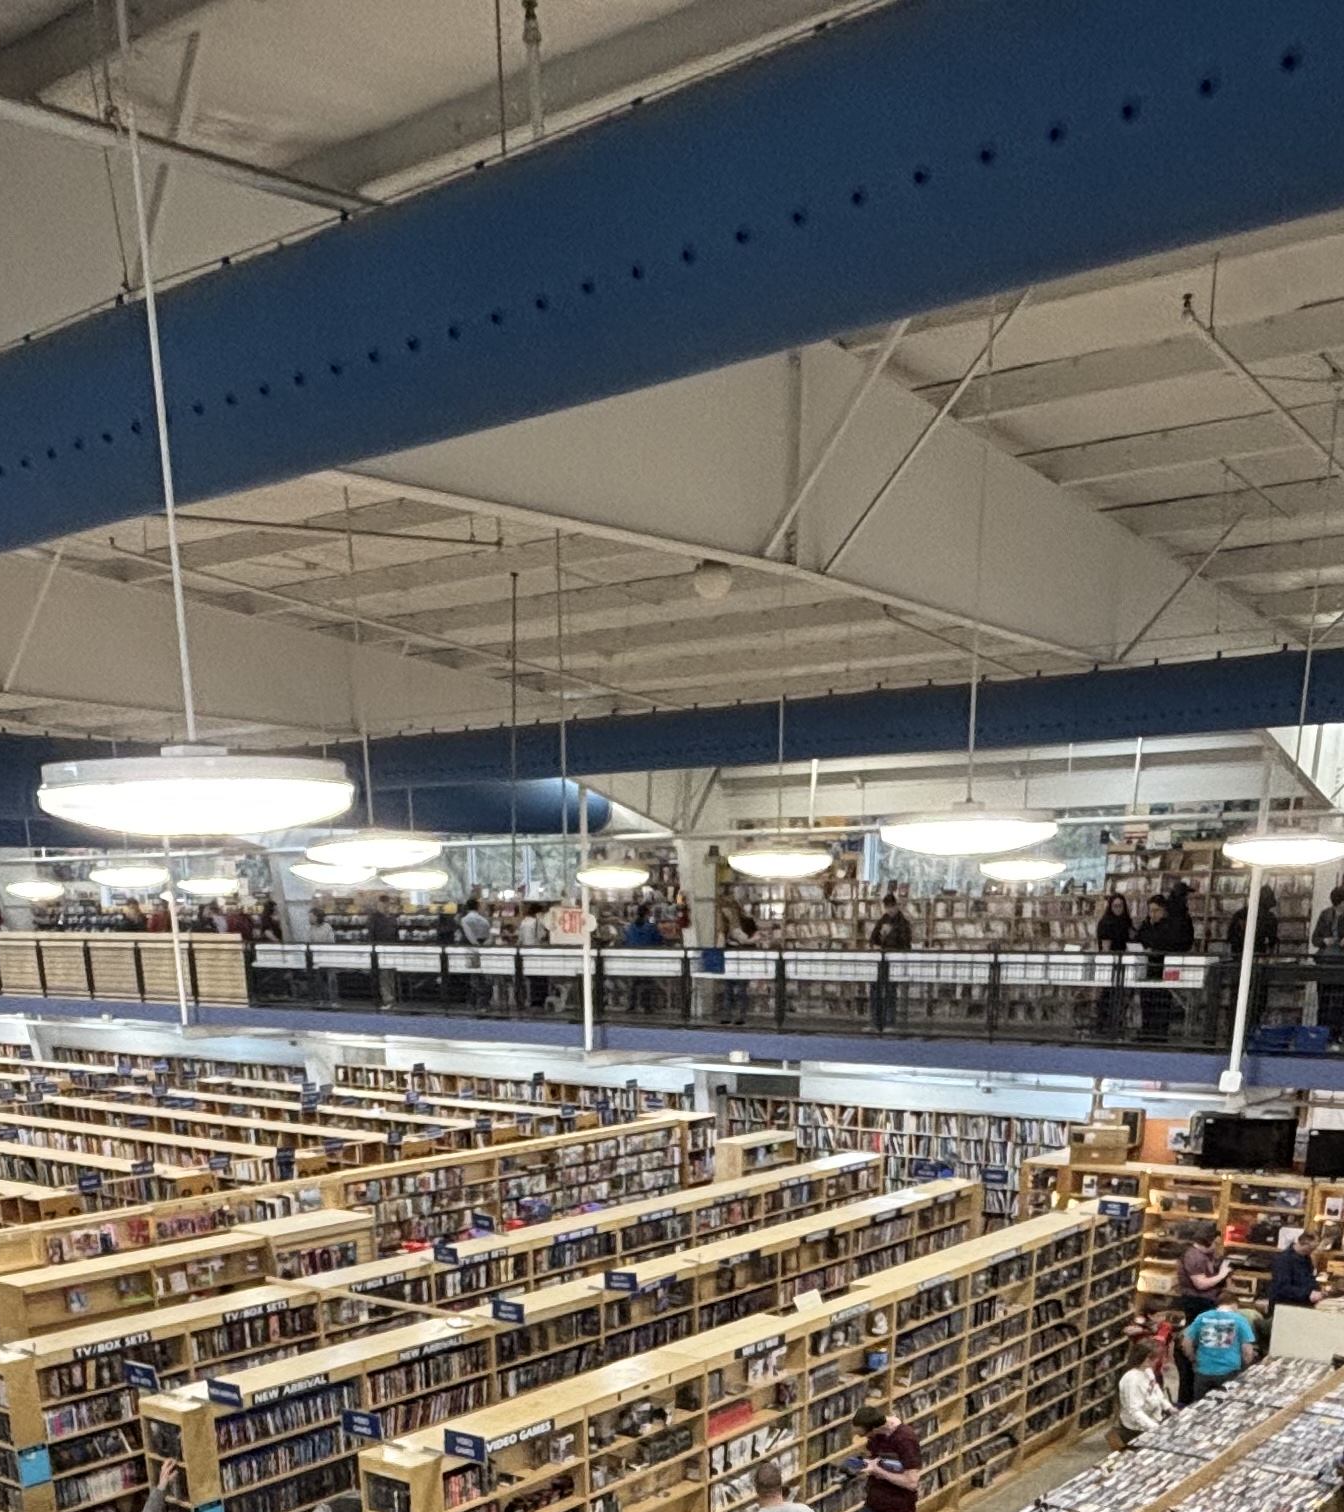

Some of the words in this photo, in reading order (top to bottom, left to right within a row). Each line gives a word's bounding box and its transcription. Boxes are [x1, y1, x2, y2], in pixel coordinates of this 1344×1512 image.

[125, 1331, 150, 1348] SETS
[255, 1386, 281, 1403] NEW
[486, 1433, 517, 1452] VIDEO
[519, 1421, 552, 1441] GAMES
